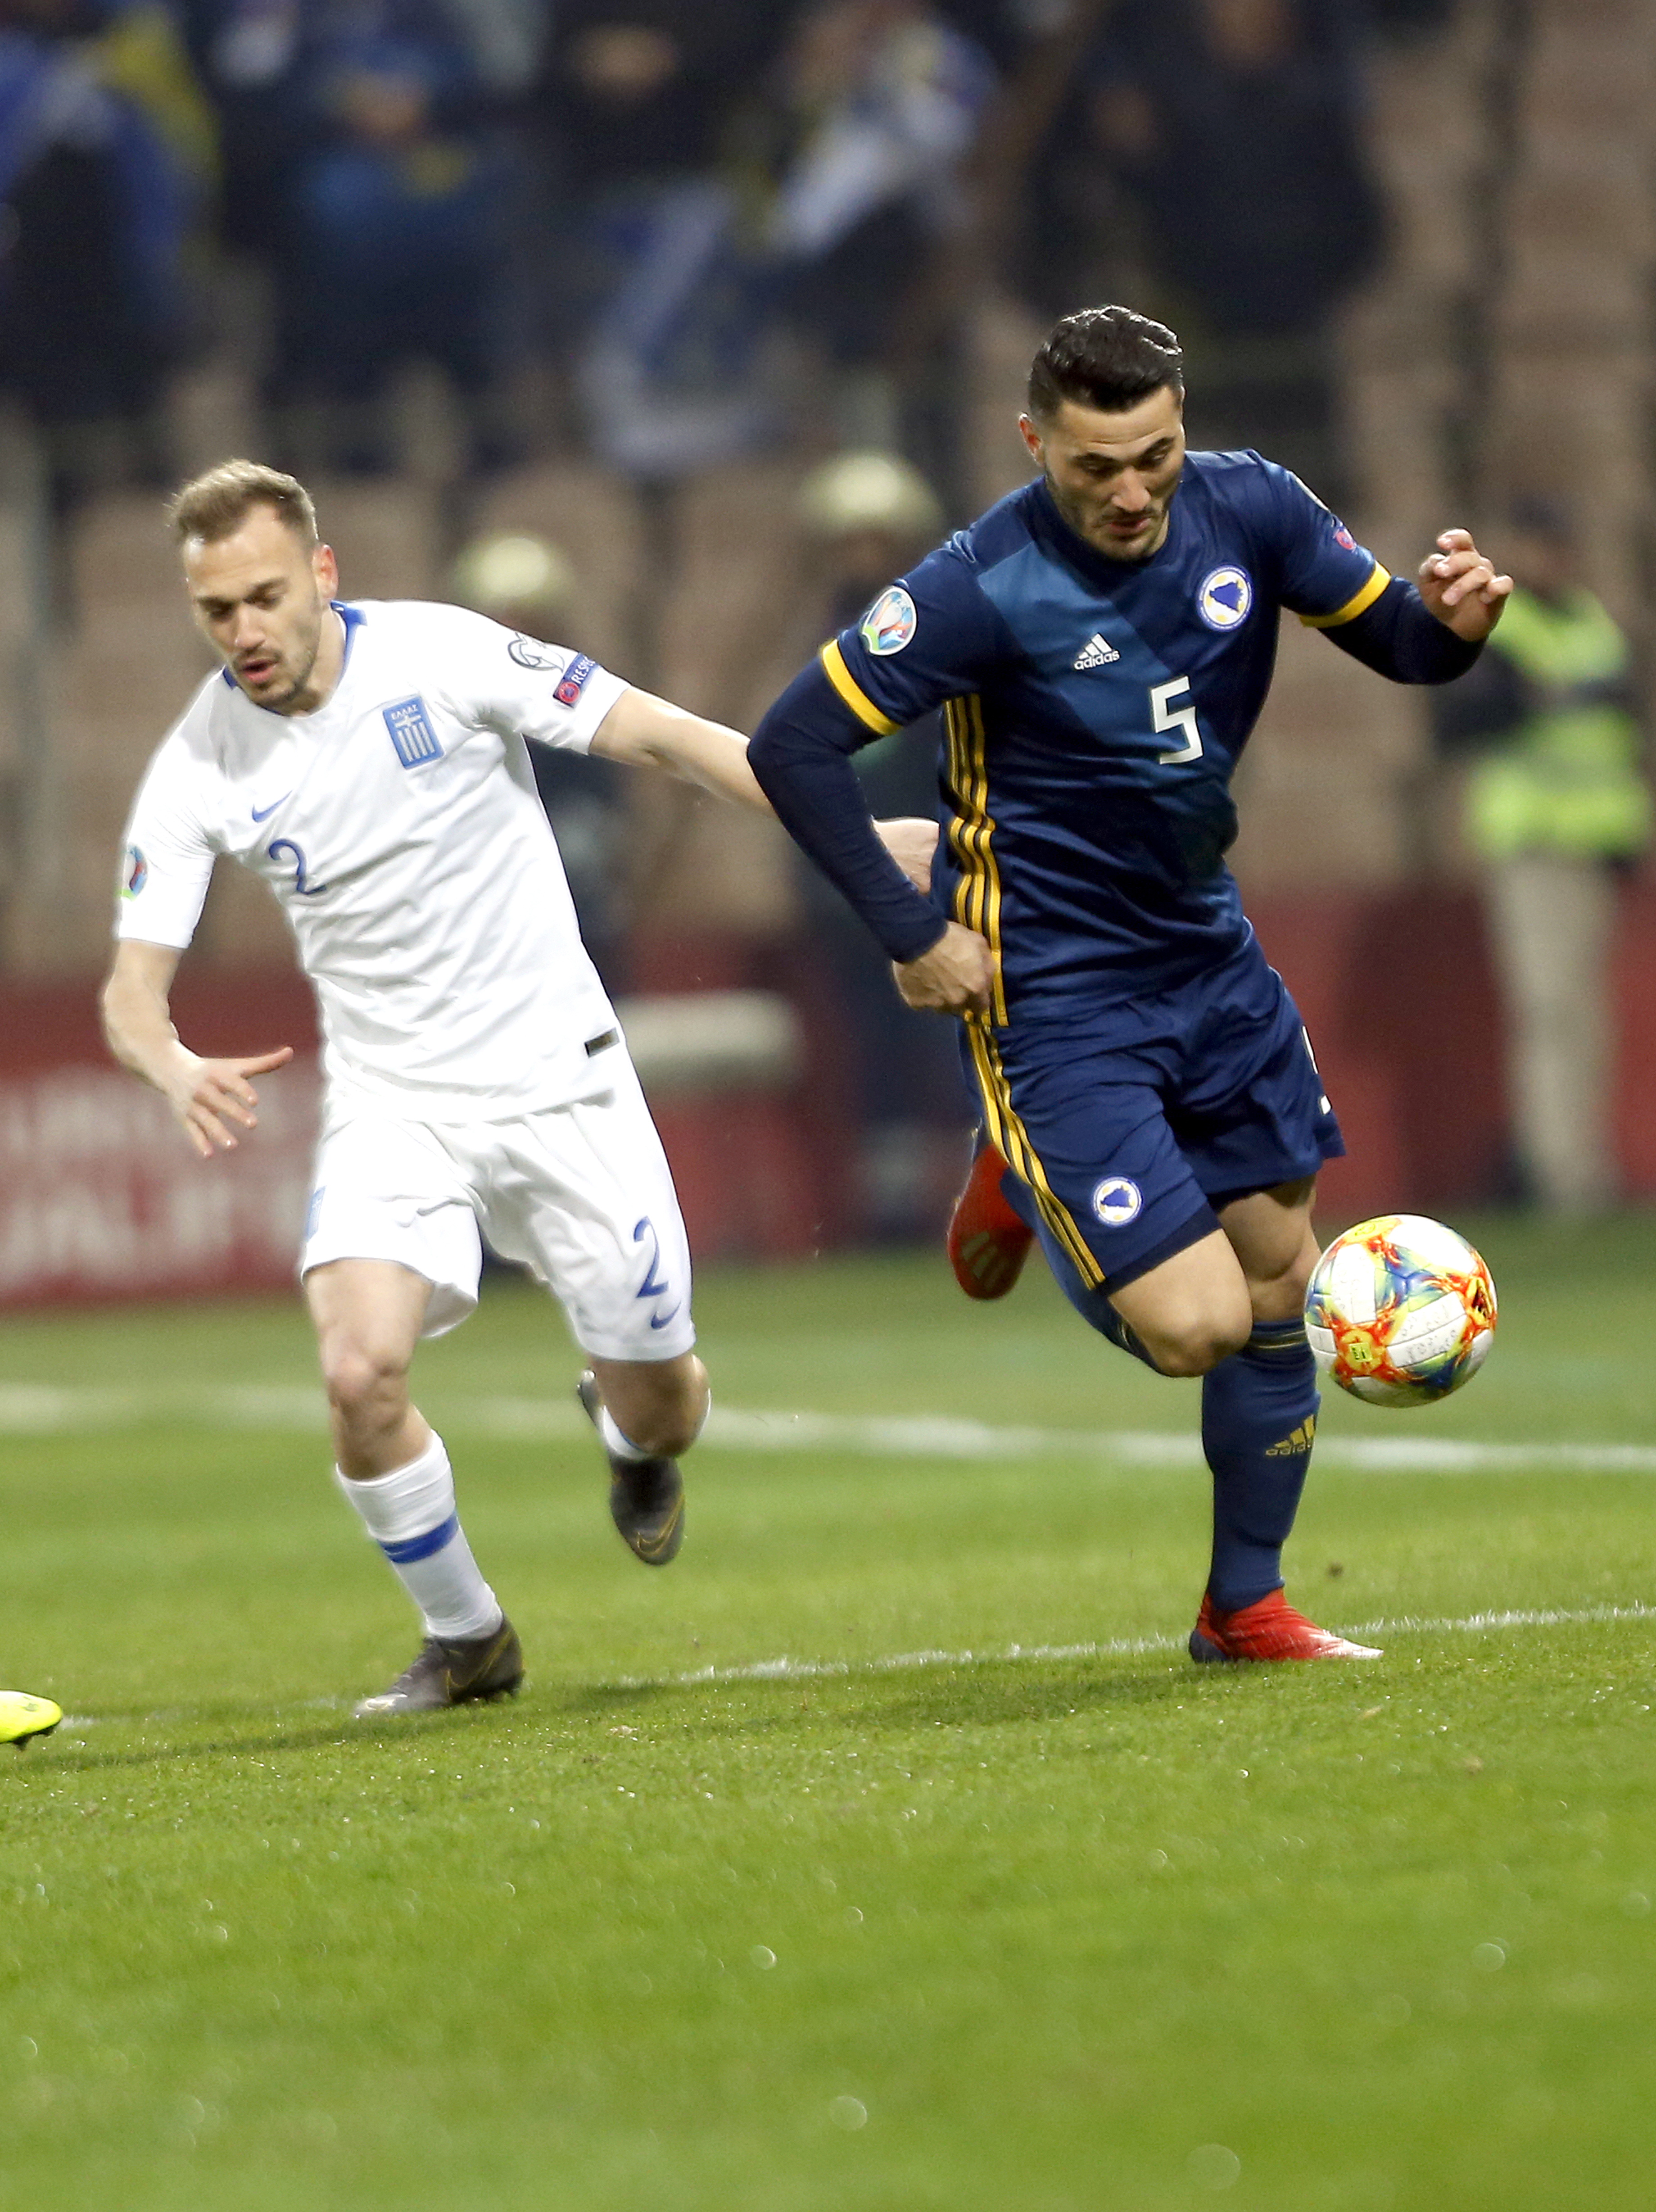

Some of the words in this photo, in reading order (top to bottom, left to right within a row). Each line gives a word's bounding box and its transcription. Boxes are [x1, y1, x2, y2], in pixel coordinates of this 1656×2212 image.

[1074, 650, 1120, 670] adidas
[1151, 675, 1203, 765] 5
[269, 839, 327, 895] 2
[633, 1215, 669, 1298] 2
